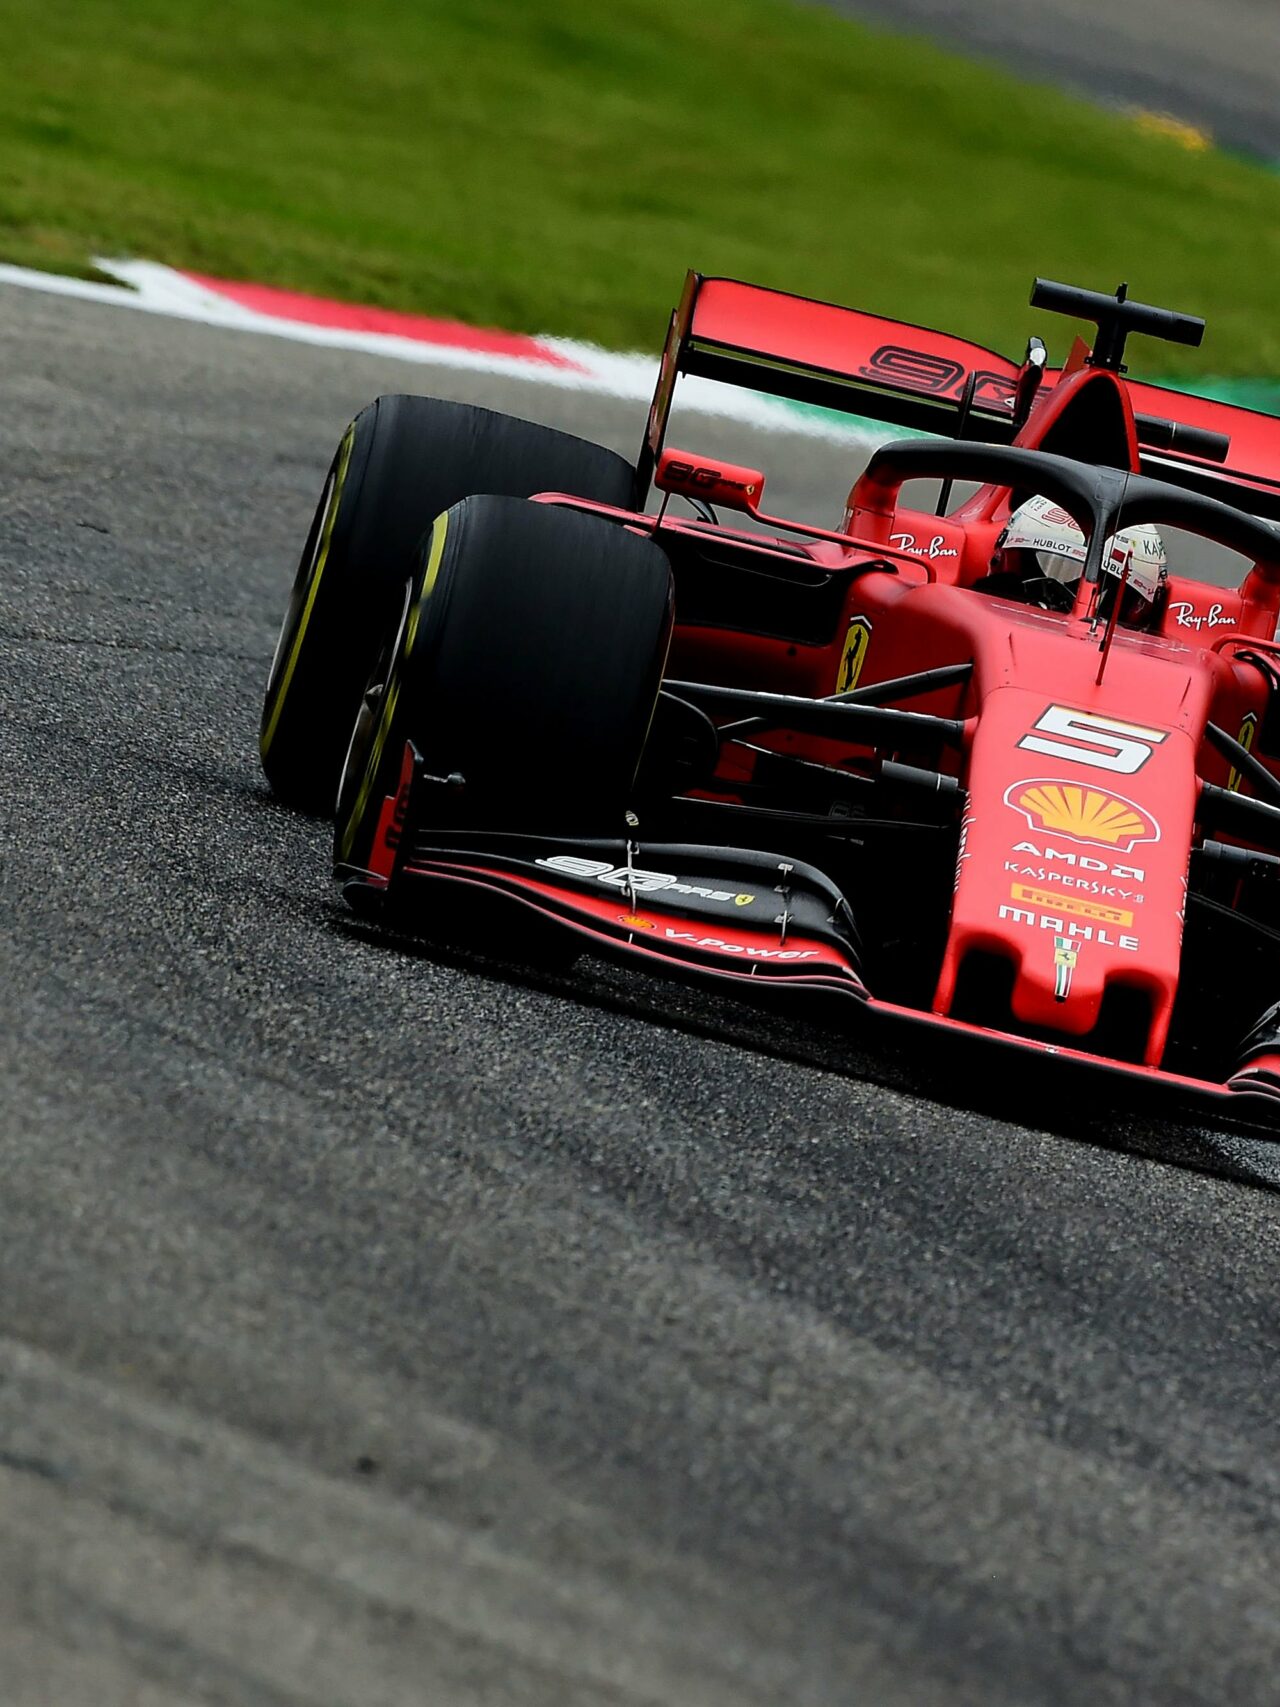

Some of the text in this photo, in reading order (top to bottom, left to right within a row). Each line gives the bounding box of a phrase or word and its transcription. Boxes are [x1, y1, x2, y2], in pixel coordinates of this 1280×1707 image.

[889, 533, 958, 559] Ray-Ban
[1032, 538, 1072, 552] HUBLOT
[1168, 602, 1236, 631] Ray-Ban
[1016, 703, 1171, 774] 5
[1004, 861, 1133, 899] KASPERSKY
[998, 904, 1139, 951] MAHLE
[664, 928, 820, 959] V-Power
